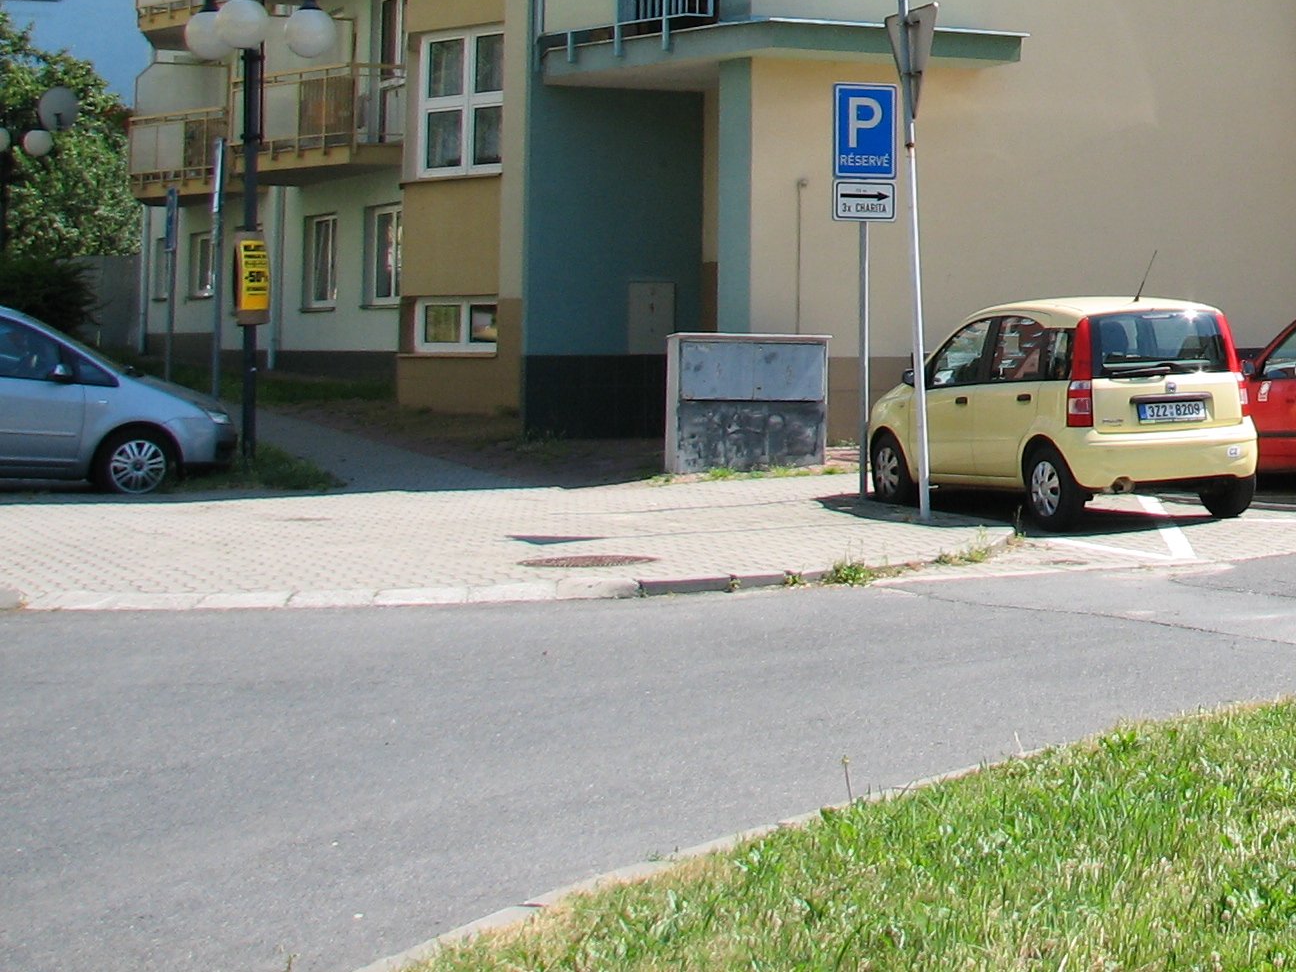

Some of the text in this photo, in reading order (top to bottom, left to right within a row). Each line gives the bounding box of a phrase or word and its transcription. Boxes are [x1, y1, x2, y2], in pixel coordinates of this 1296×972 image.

[848, 96, 883, 148] P
[840, 153, 890, 167] RÉSERVÉ
[855, 203, 887, 213] CHARITA
[1148, 402, 1201, 418] 3Z2 8209
